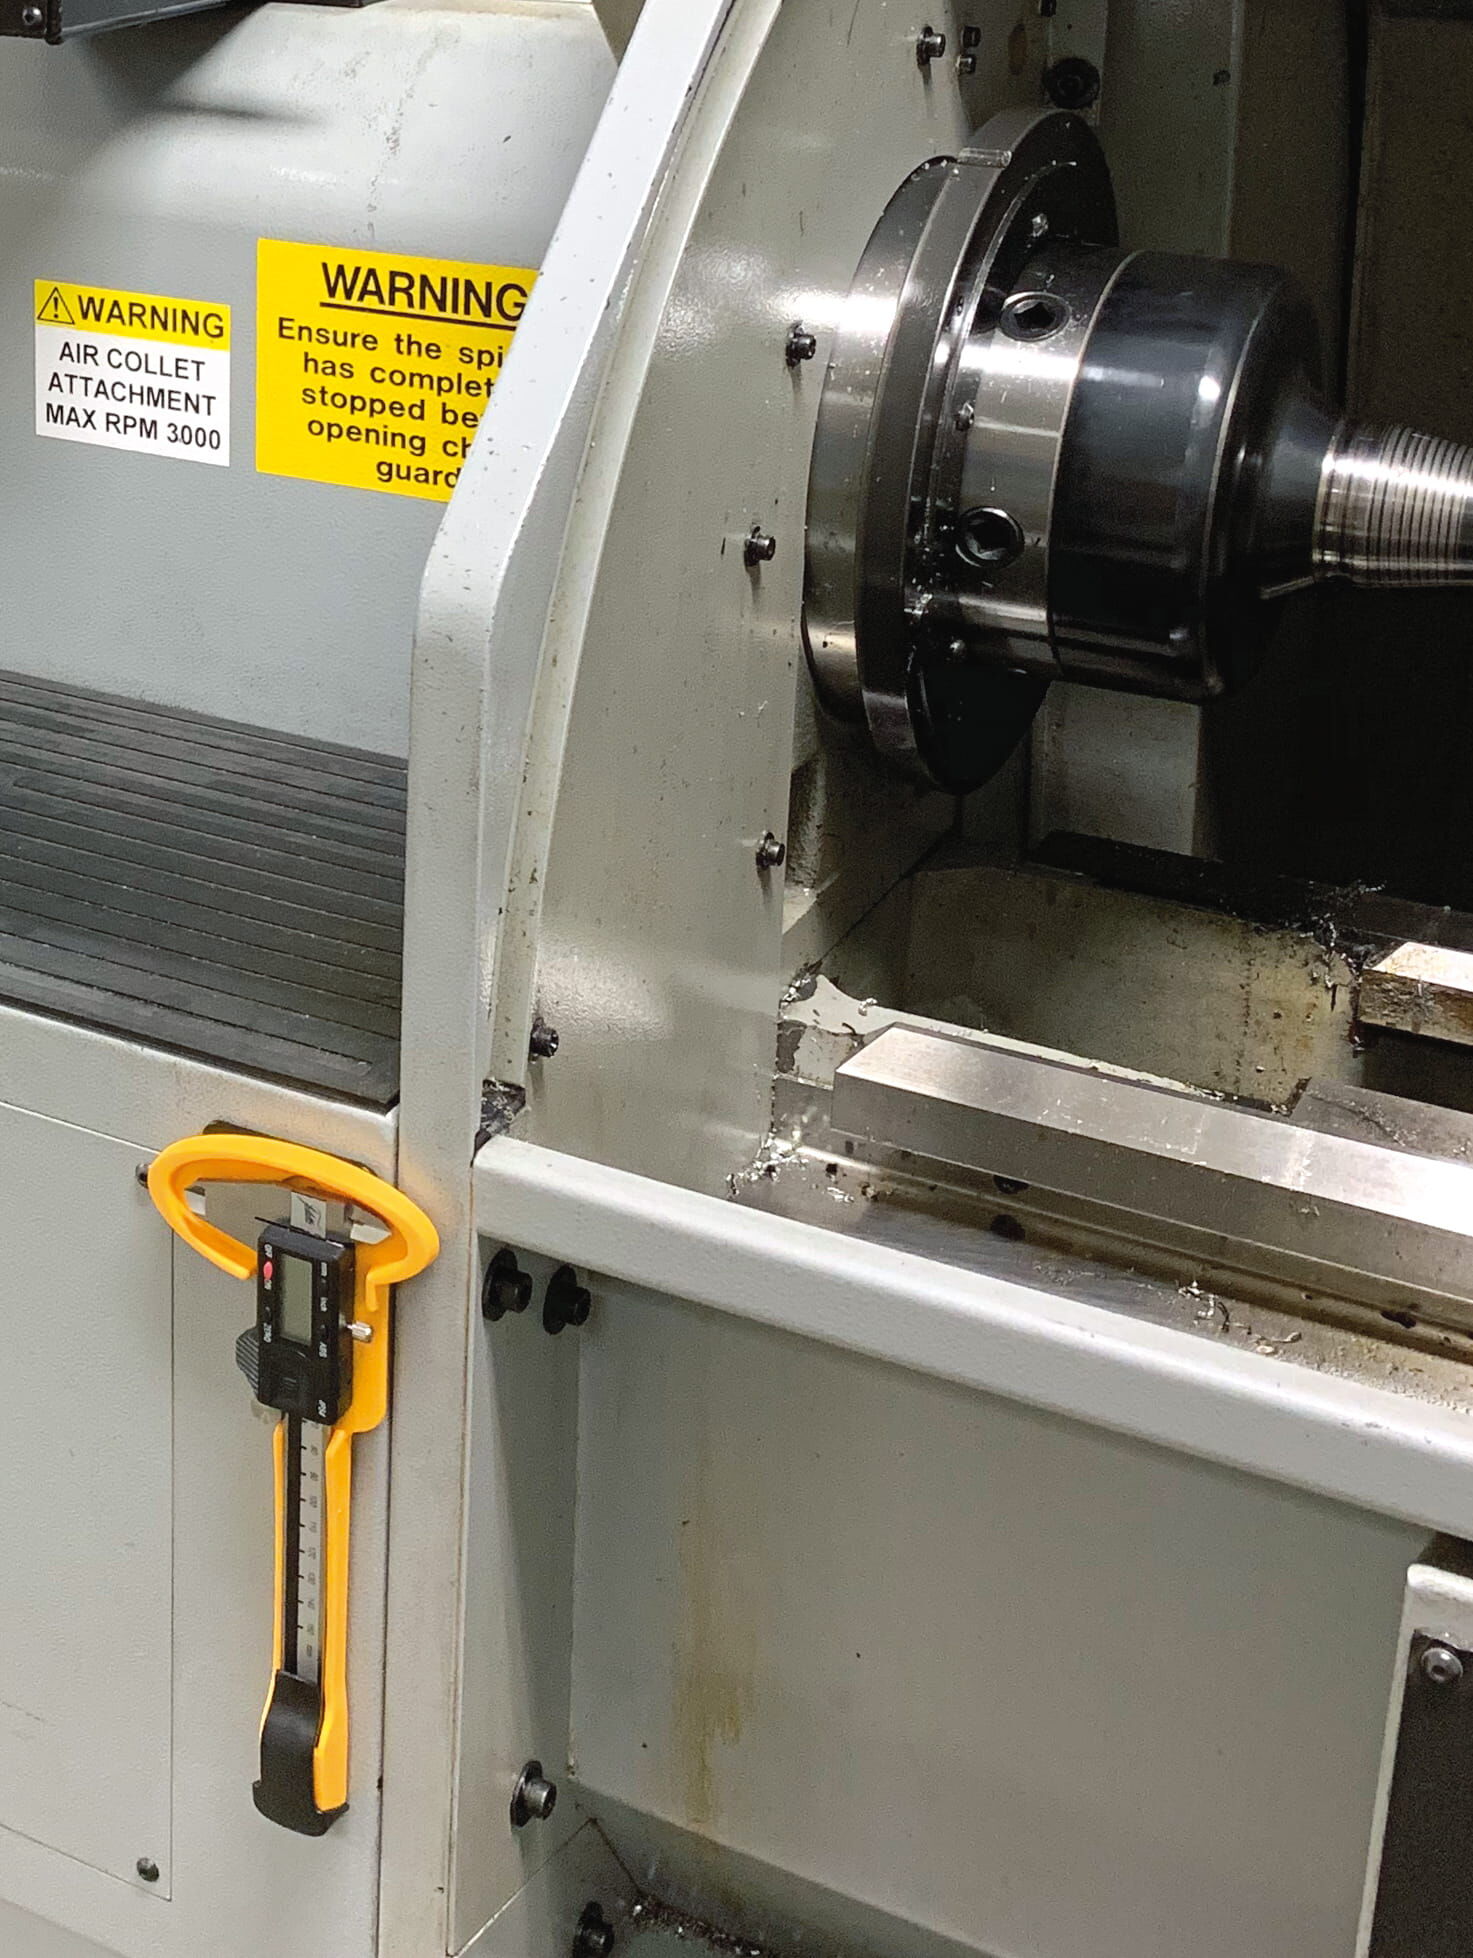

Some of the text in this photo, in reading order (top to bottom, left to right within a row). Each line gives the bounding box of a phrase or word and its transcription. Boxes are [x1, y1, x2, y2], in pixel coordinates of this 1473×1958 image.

[321, 261, 529, 322] WARNING
[77, 294, 225, 339] WARNING
[278, 317, 378, 351] Ensure
[394, 333, 442, 360] the
[59, 341, 206, 382] AIR COLLET
[303, 352, 354, 379] has
[48, 372, 217, 416] ATTACHMENT
[301, 385, 425, 421] stopped
[46, 403, 221, 450] MAX RPM 3000
[307, 418, 426, 457] opening
[376, 460, 462, 488] guard
